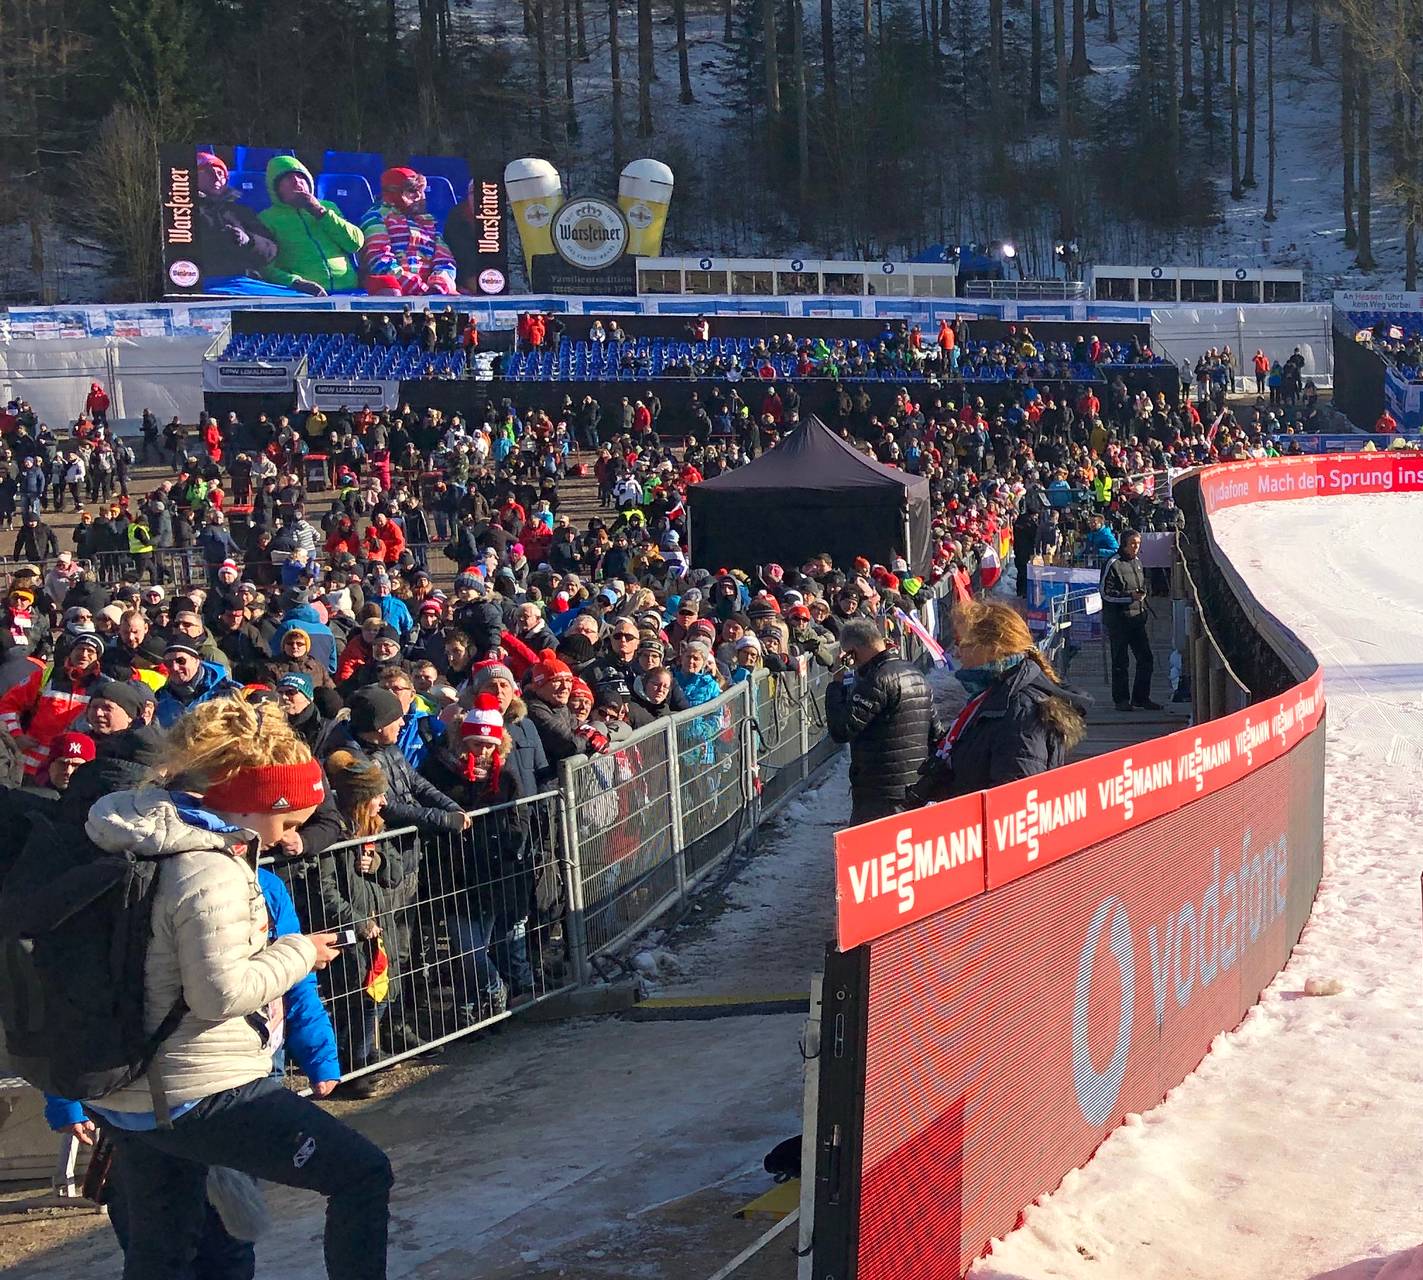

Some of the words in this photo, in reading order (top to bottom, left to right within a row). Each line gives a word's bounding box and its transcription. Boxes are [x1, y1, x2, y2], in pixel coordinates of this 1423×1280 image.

[165, 167, 194, 244] Warsteiner
[476, 181, 501, 254] Warsteiner
[559, 224, 621, 243] Warsteiner
[1258, 473, 1295, 494] Mach
[1298, 473, 1325, 490] den
[1330, 469, 1393, 490] Sprung
[848, 823, 983, 914] VIESSMANN
[993, 789, 1087, 862] VIESSMANN
[1098, 758, 1173, 821] VIESSMANN
[1177, 737, 1231, 792] VIESSMANN
[1235, 718, 1270, 766] VIESSMANN
[1148, 828, 1288, 1024] vodafone
